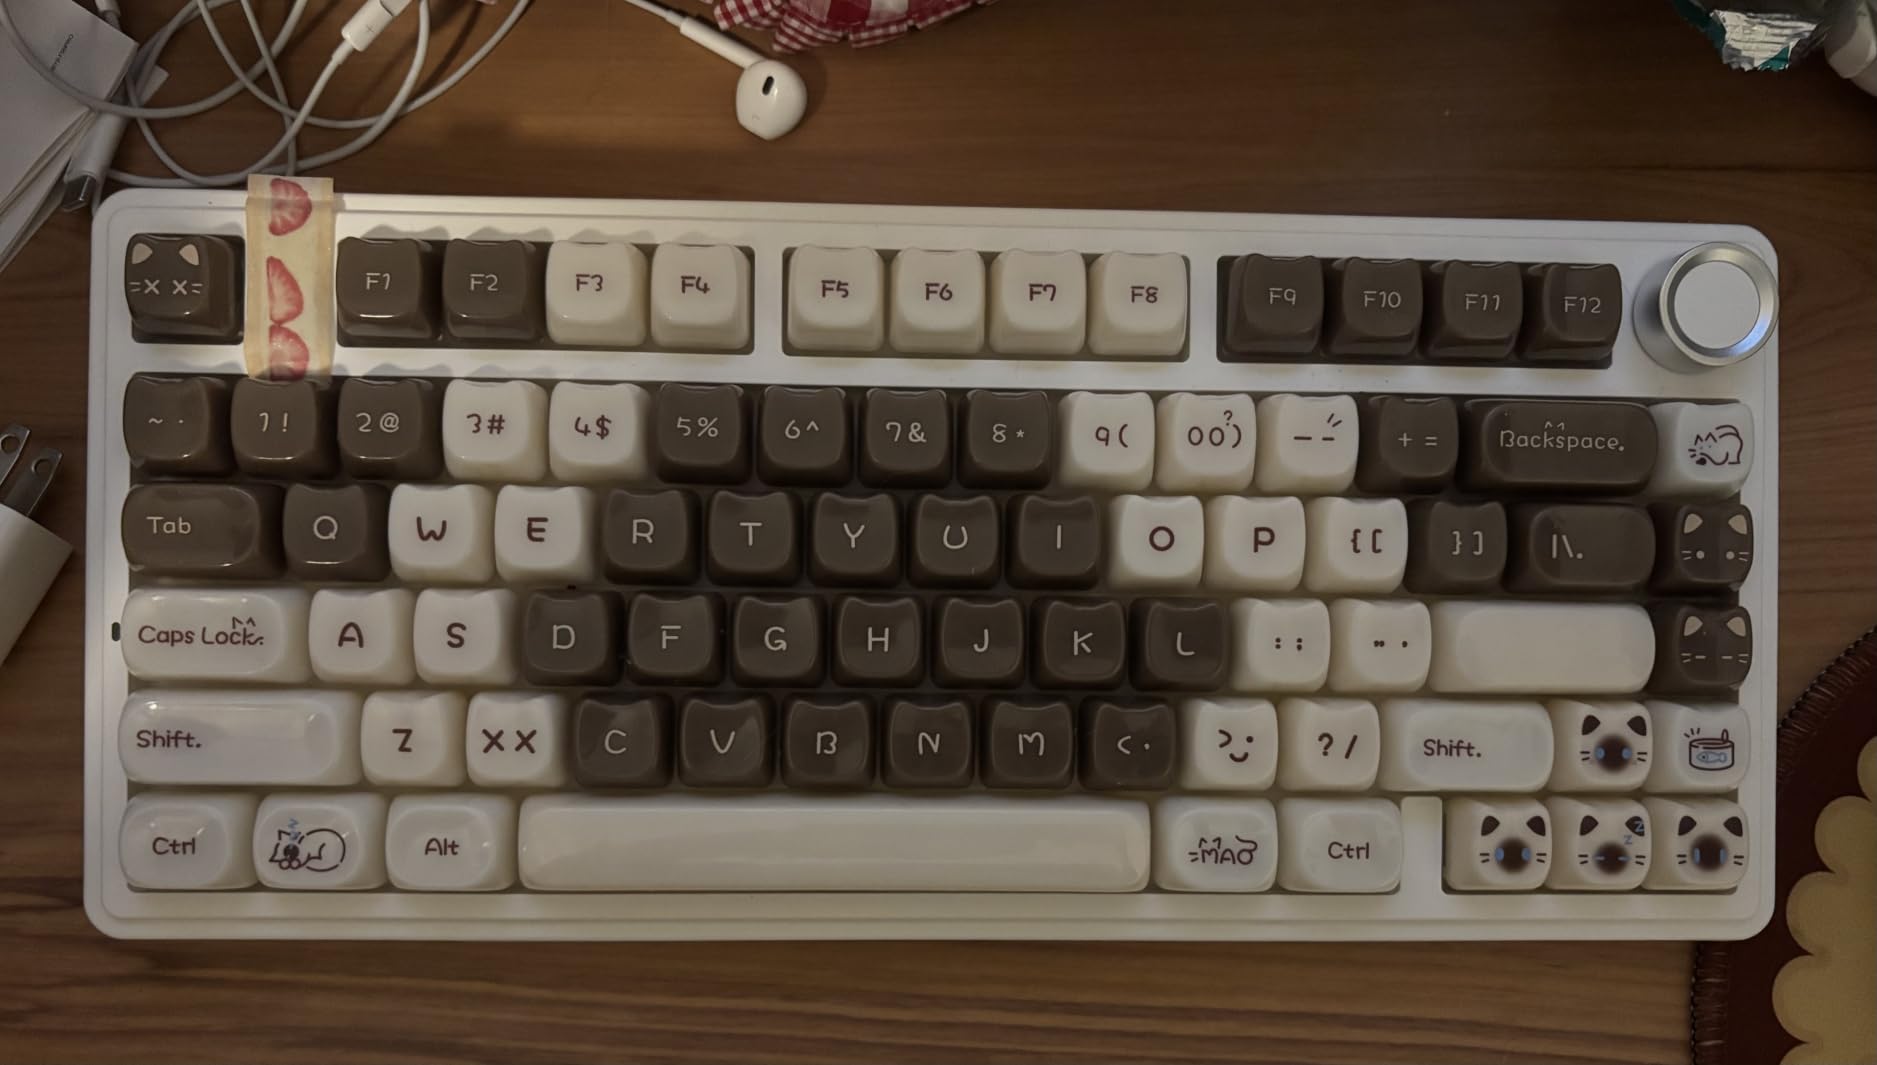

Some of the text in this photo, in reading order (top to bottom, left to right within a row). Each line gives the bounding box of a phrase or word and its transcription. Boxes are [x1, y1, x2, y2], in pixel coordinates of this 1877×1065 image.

[366, 273, 390, 289] F1
[470, 274, 497, 290] F2
[576, 274, 603, 291] F3
[681, 276, 710, 294] F4
[821, 280, 848, 298] F5
[925, 283, 952, 301] F6
[1029, 284, 1056, 301] F7
[1131, 286, 1158, 303] F8
[1270, 288, 1296, 304] F9
[1364, 291, 1401, 307] F10
[1466, 294, 1500, 310] F11
[1565, 297, 1600, 313] F12
[147, 517, 191, 534] Tab
[314, 516, 337, 539] Q
[417, 517, 447, 541] W
[527, 517, 548, 542] E
[633, 519, 653, 544] R
[740, 523, 762, 545] T
[844, 523, 864, 548] Y
[943, 525, 967, 549] U
[1149, 526, 1174, 551] O
[1254, 527, 1275, 553] P
[138, 625, 195, 647] Caps
[338, 622, 364, 648] A
[447, 623, 466, 648] S
[553, 625, 575, 649] D
[661, 626, 681, 648] F
[765, 627, 786, 650] G
[868, 627, 889, 651] H
[974, 629, 988, 652] J
[1074, 631, 1092, 655] K
[1177, 632, 1194, 655] L
[392, 729, 412, 752] Z
[605, 730, 626, 754] C
[710, 730, 735, 753] V
[817, 731, 837, 754] B
[919, 732, 940, 754] N
[1019, 732, 1044, 755] M
[152, 837, 195, 855] Ctrl
[425, 838, 459, 856] Alt
[1328, 842, 1369, 859] Ctrl
